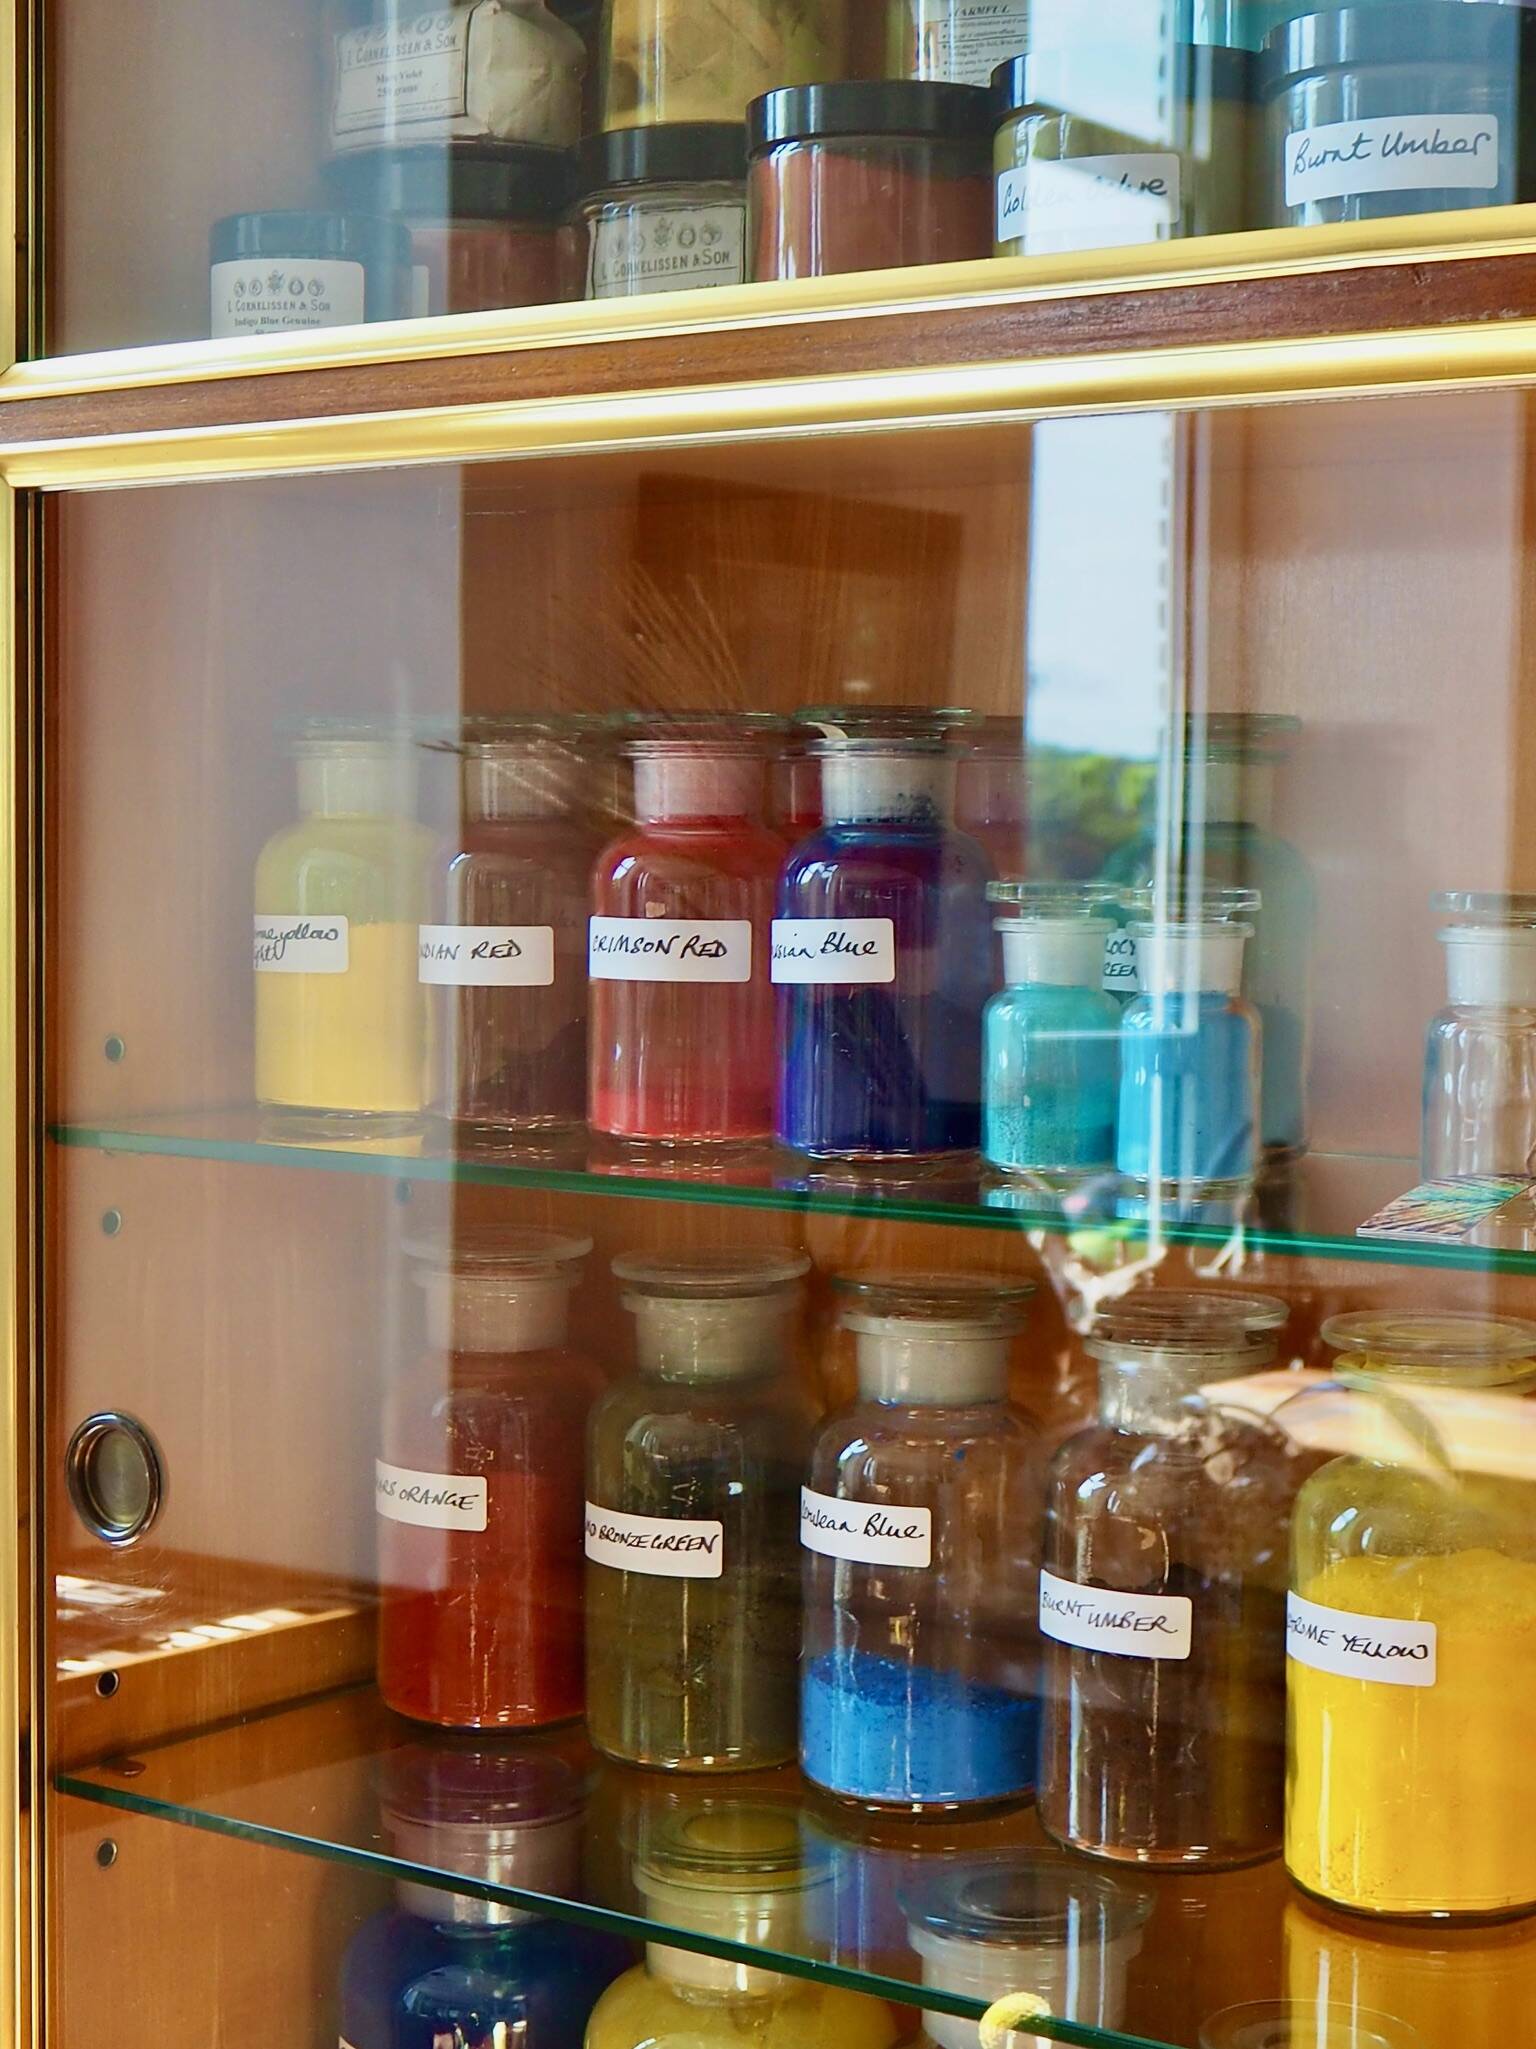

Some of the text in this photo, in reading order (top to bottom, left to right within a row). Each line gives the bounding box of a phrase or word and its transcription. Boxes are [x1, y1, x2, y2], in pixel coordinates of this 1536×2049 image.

[1293, 128, 1491, 175] Burnt Umber
[702, 247, 730, 265] SON
[471, 938, 522, 960] RED
[592, 934, 728, 959] CRIMSON RED
[820, 931, 878, 956] Blue
[399, 1485, 480, 1511] ORANGE
[863, 1512, 925, 1539] Blue
[650, 1534, 720, 1554] GREEN
[1041, 1591, 1179, 1634] BURNT UMBER
[1342, 1633, 1429, 1660] YELLOW
